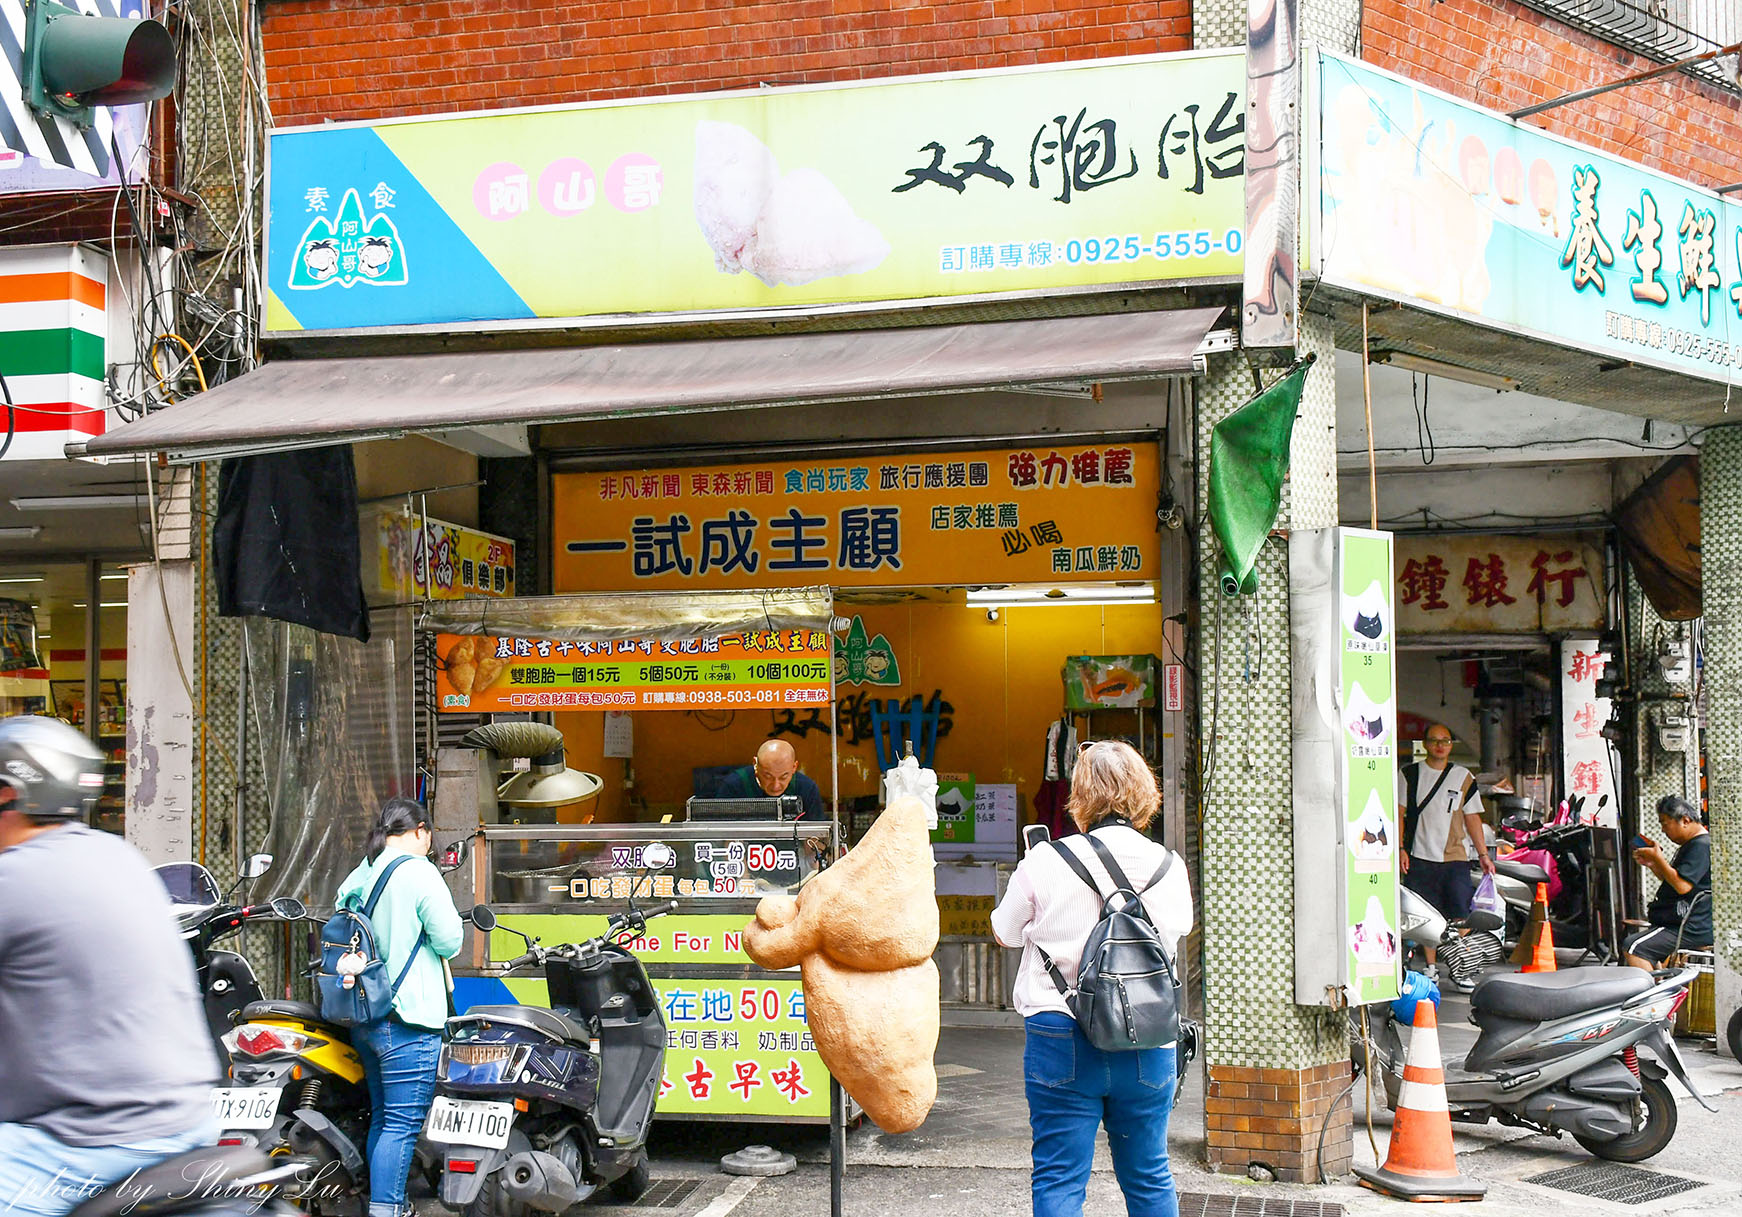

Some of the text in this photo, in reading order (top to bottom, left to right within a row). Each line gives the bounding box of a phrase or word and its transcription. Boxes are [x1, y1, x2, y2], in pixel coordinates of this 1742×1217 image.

[488, 164, 662, 217] 阿山哥
[340, 219, 359, 273] 阿山哥
[1558, 163, 1742, 329] 養生鮮
[600, 447, 1135, 501] 非凡新聞 東森新聞 食尚玩家 旅行應援團 強力推薦
[930, 502, 1019, 530] 店家推薦
[567, 506, 902, 576] 一試成主顧
[1000, 520, 1064, 557] 必喝
[1051, 546, 1142, 572] 南瓜鮮奶
[510, 663, 827, 684] 雙胞胎一個15元 5個50元 10個100元
[1363, 655, 1373, 666] 35
[784, 689, 829, 702] 全年無休
[1367, 760, 1376, 770] 40
[695, 844, 744, 862] 買一份
[1369, 874, 1378, 884] 40
[618, 933, 660, 951] One
[674, 934, 711, 951] For
